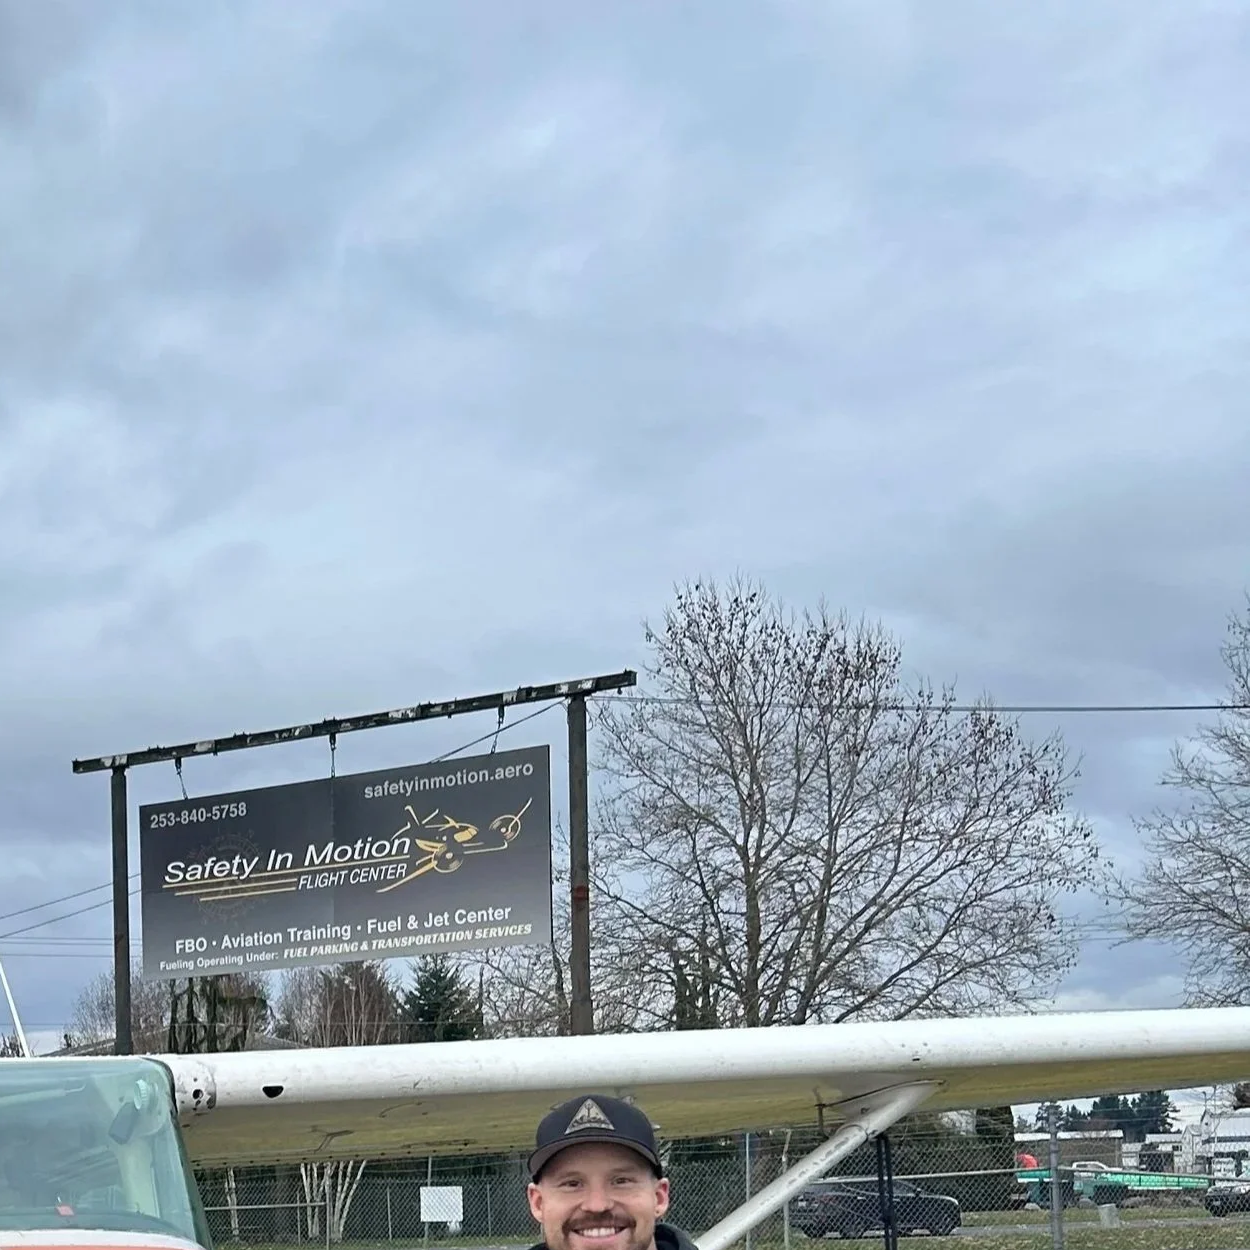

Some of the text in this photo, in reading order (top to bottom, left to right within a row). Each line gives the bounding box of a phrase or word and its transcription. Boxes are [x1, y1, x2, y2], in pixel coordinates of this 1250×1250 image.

[364, 763, 534, 799] safetyinmotion.aero
[150, 802, 247, 828] 253-840-5758
[164, 836, 411, 884] Safety In Motion
[298, 863, 407, 890] FLIGHT CENTER
[160, 923, 533, 972] Fueling Operating Under: FUEL PARKING & TRANSPORTATION SERVICES
[175, 906, 512, 954] FBO Aviation Training Fuel & Jet Center
